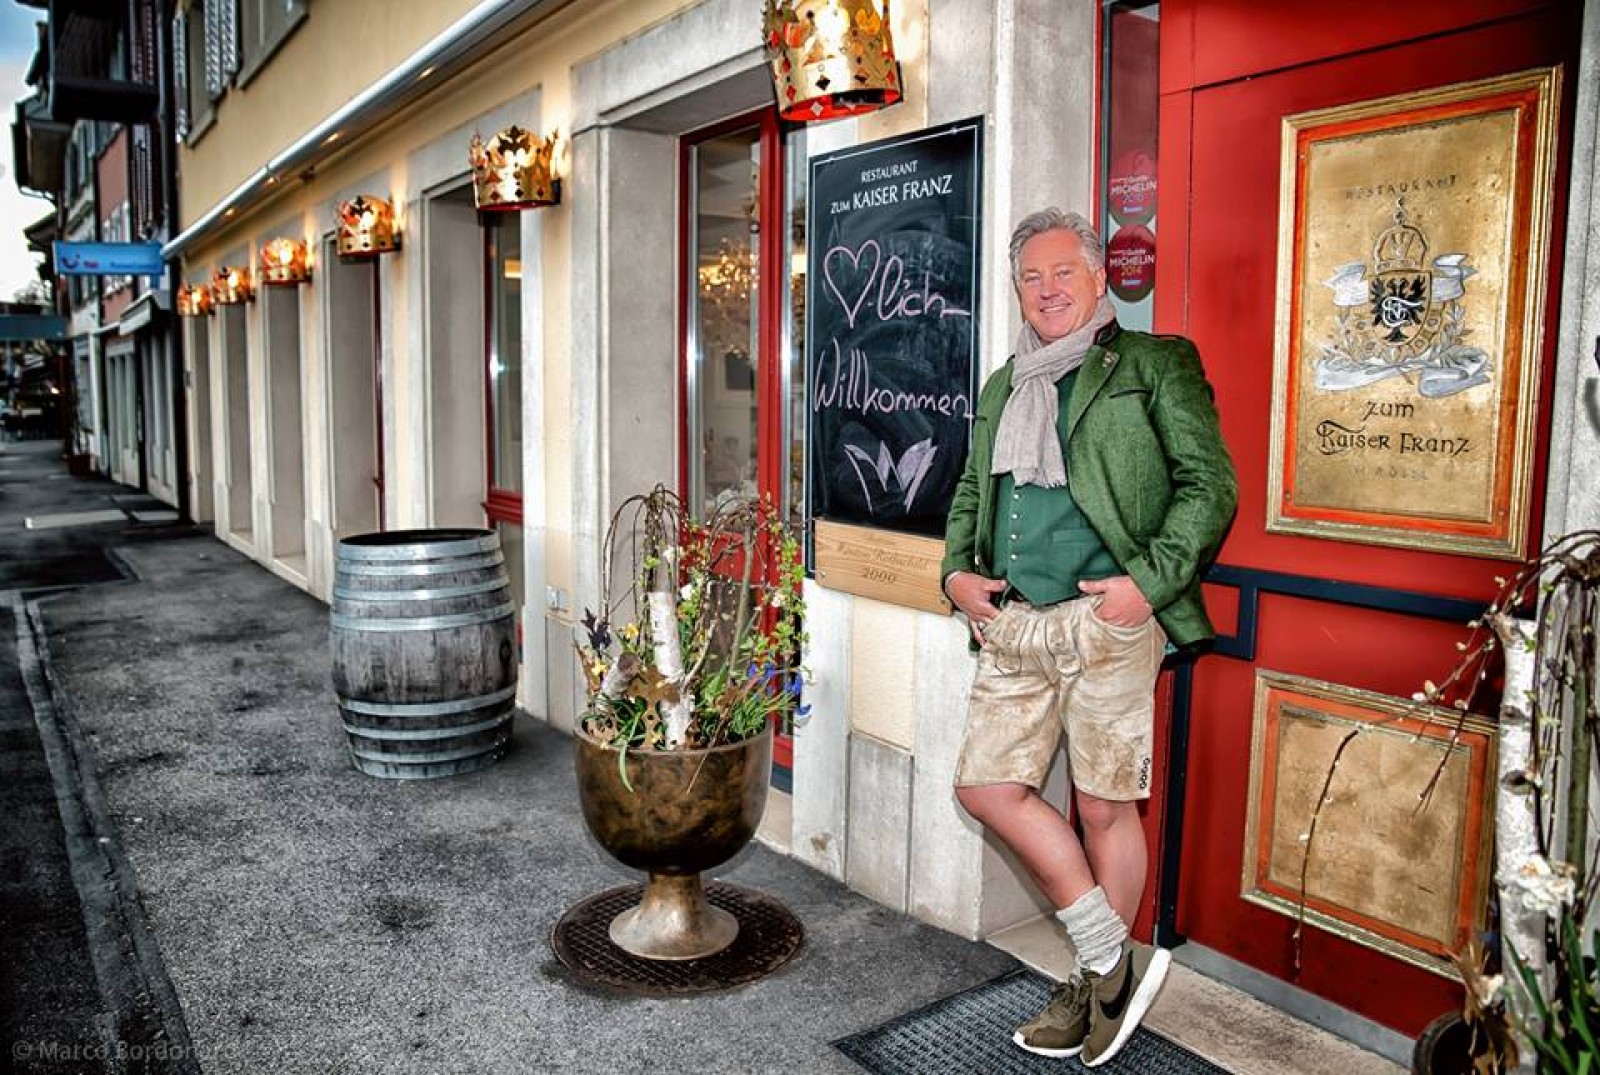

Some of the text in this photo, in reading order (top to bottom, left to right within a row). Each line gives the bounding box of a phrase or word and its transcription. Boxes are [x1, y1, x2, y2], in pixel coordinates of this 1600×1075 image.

[861, 160, 918, 183] RESTAURANT
[830, 174, 953, 214] ZUM KAISER FRANZ
[1110, 180, 1157, 196] MICHELIN
[1109, 254, 1155, 268] MICHELIN
[814, 336, 976, 419] Willkommen
[1362, 401, 1414, 421] zum
